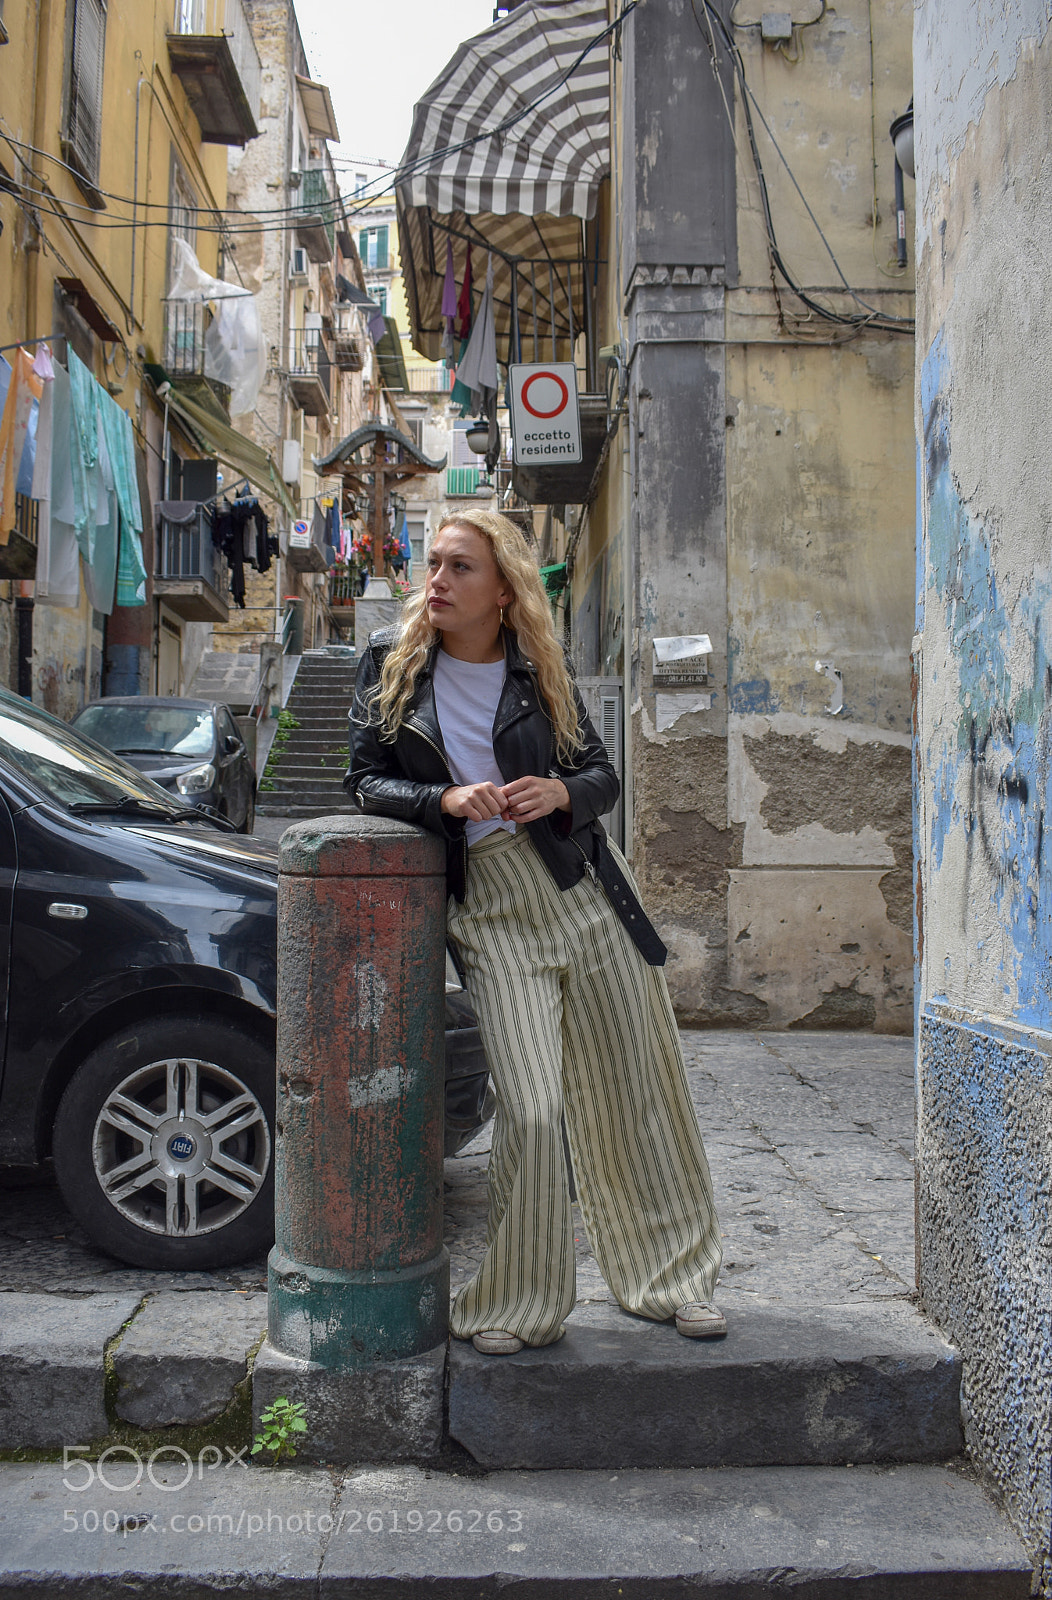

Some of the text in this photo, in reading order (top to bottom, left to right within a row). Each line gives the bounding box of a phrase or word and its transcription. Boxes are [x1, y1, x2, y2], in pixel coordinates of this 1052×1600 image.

[524, 429, 571, 441] eccetto
[521, 443, 575, 455] residenti
[172, 1141, 191, 1153] FIAT
